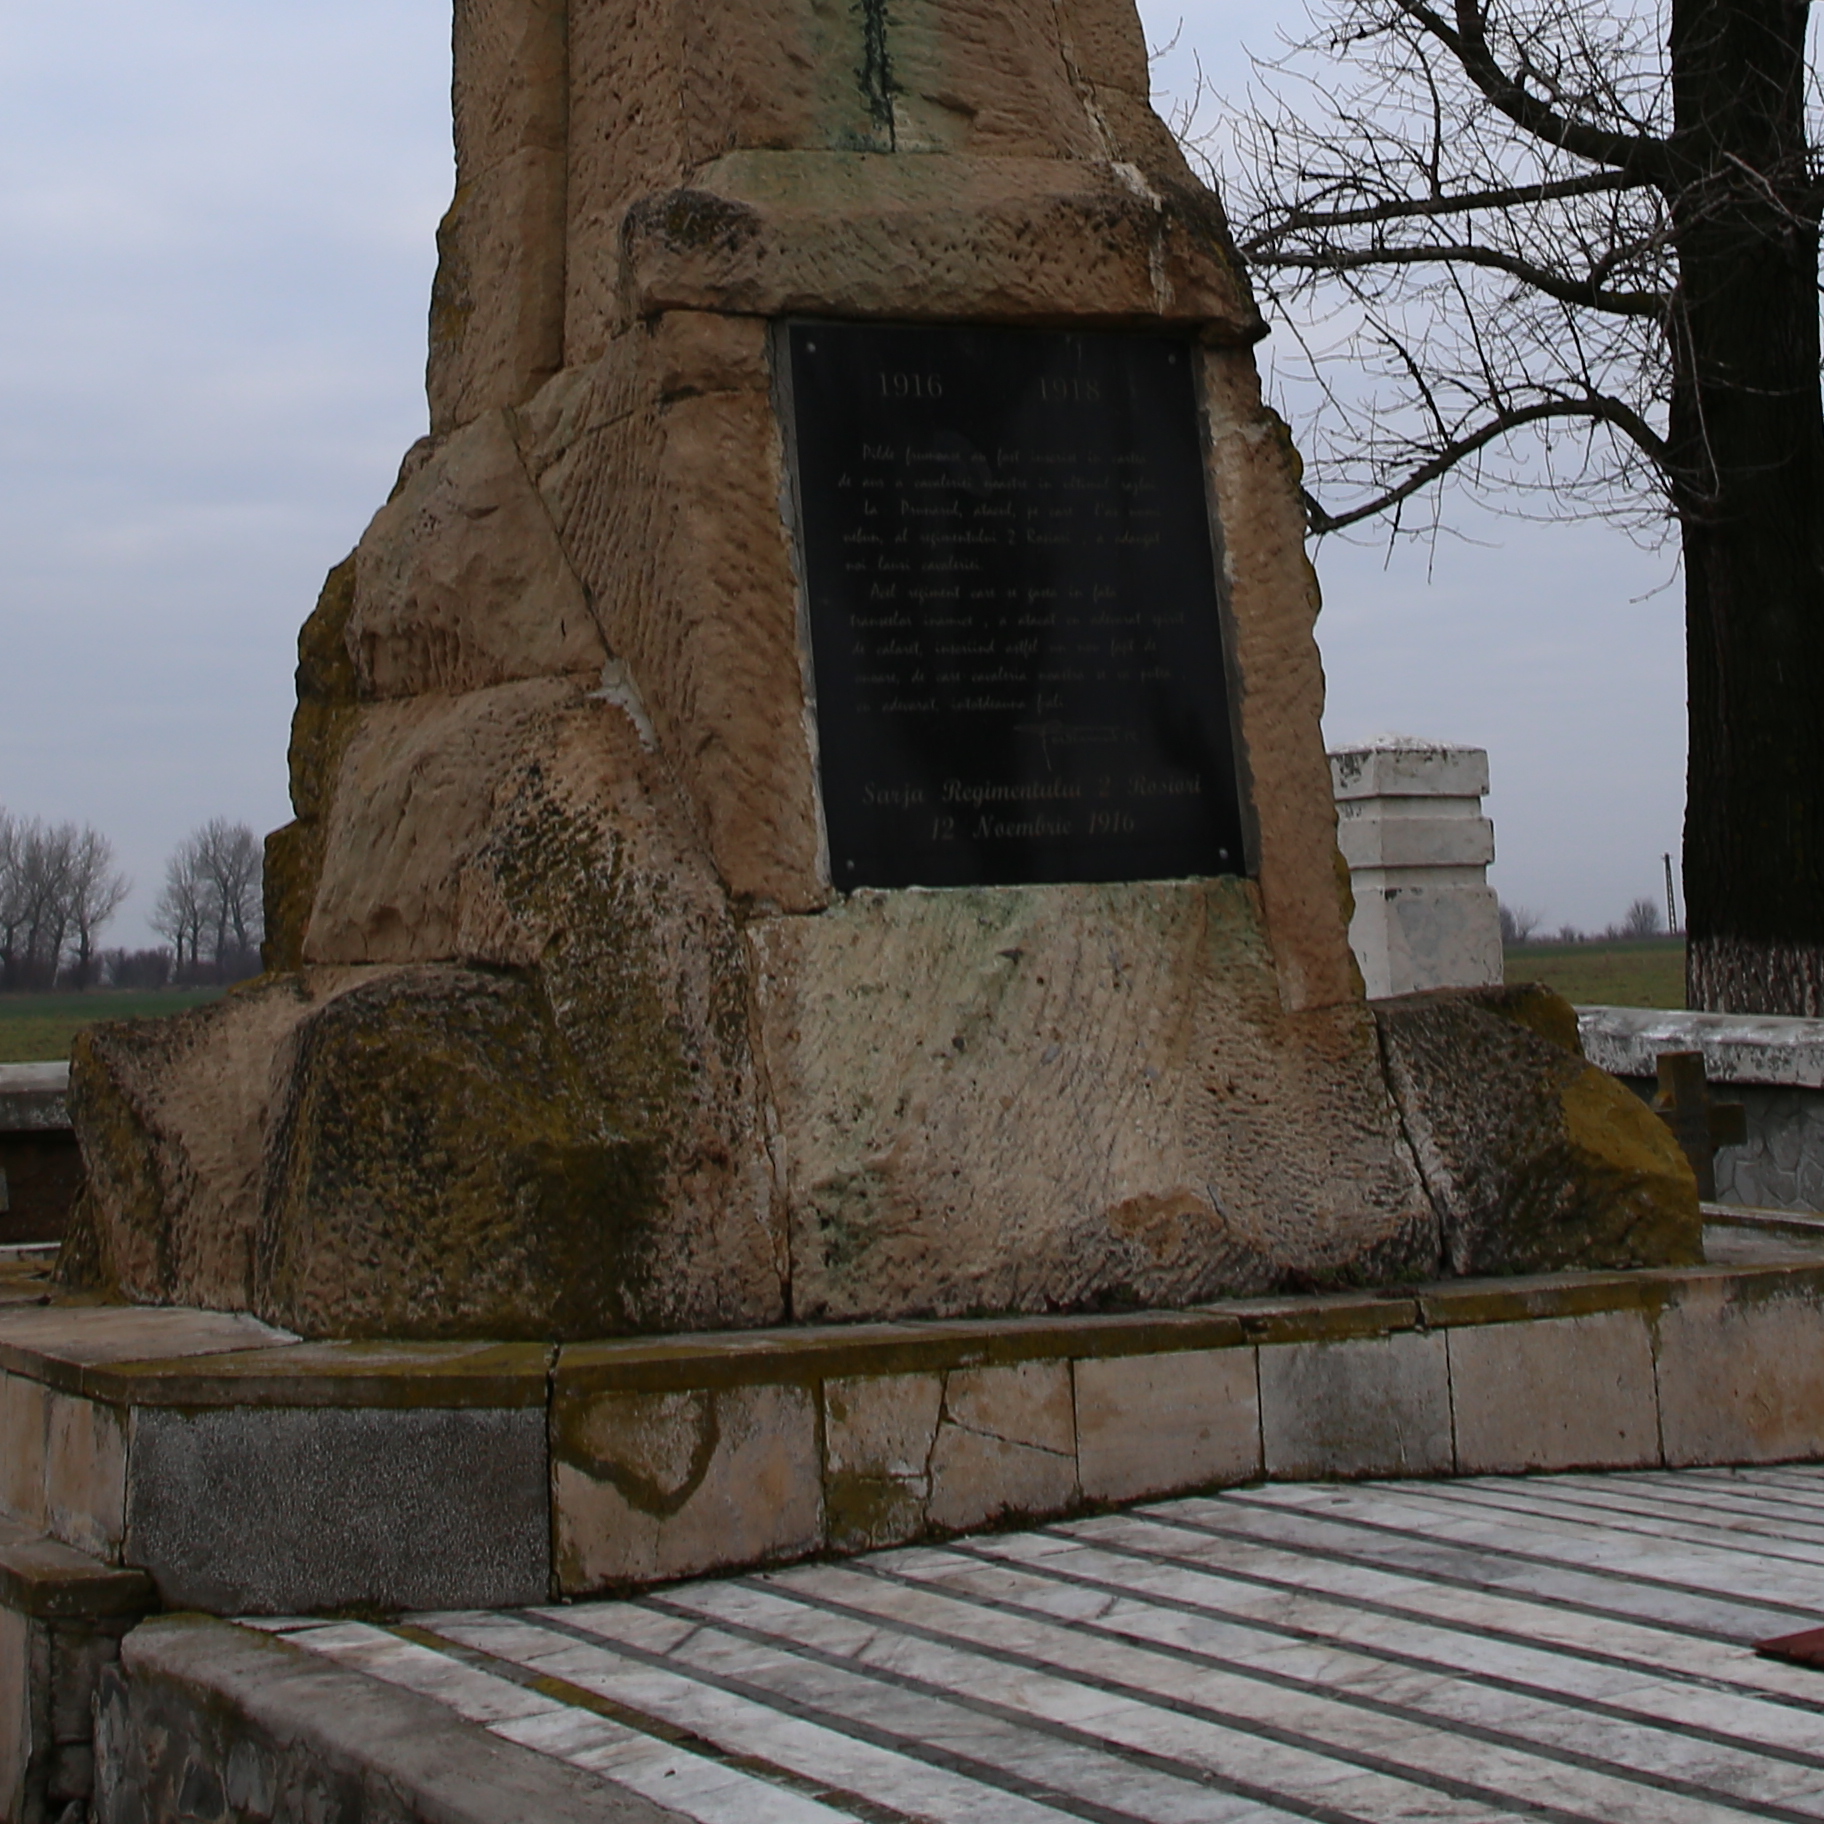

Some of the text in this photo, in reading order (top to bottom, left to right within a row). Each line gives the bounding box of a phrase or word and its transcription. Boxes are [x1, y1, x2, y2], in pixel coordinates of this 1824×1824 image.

[878, 372, 1100, 402] 1916 1918
[997, 446, 1020, 468] fost
[838, 472, 852, 488] de
[864, 498, 878, 516] La
[895, 526, 908, 543] al
[1007, 528, 1015, 546] 2
[908, 585, 960, 606] regiment
[970, 588, 995, 599] care
[852, 641, 865, 656] de
[1144, 637, 1156, 652] de
[911, 668, 924, 684] de
[862, 774, 1200, 810] Sarja Regimentului 2 Rosiori
[932, 810, 1135, 841] 12 Noembrie 1916
